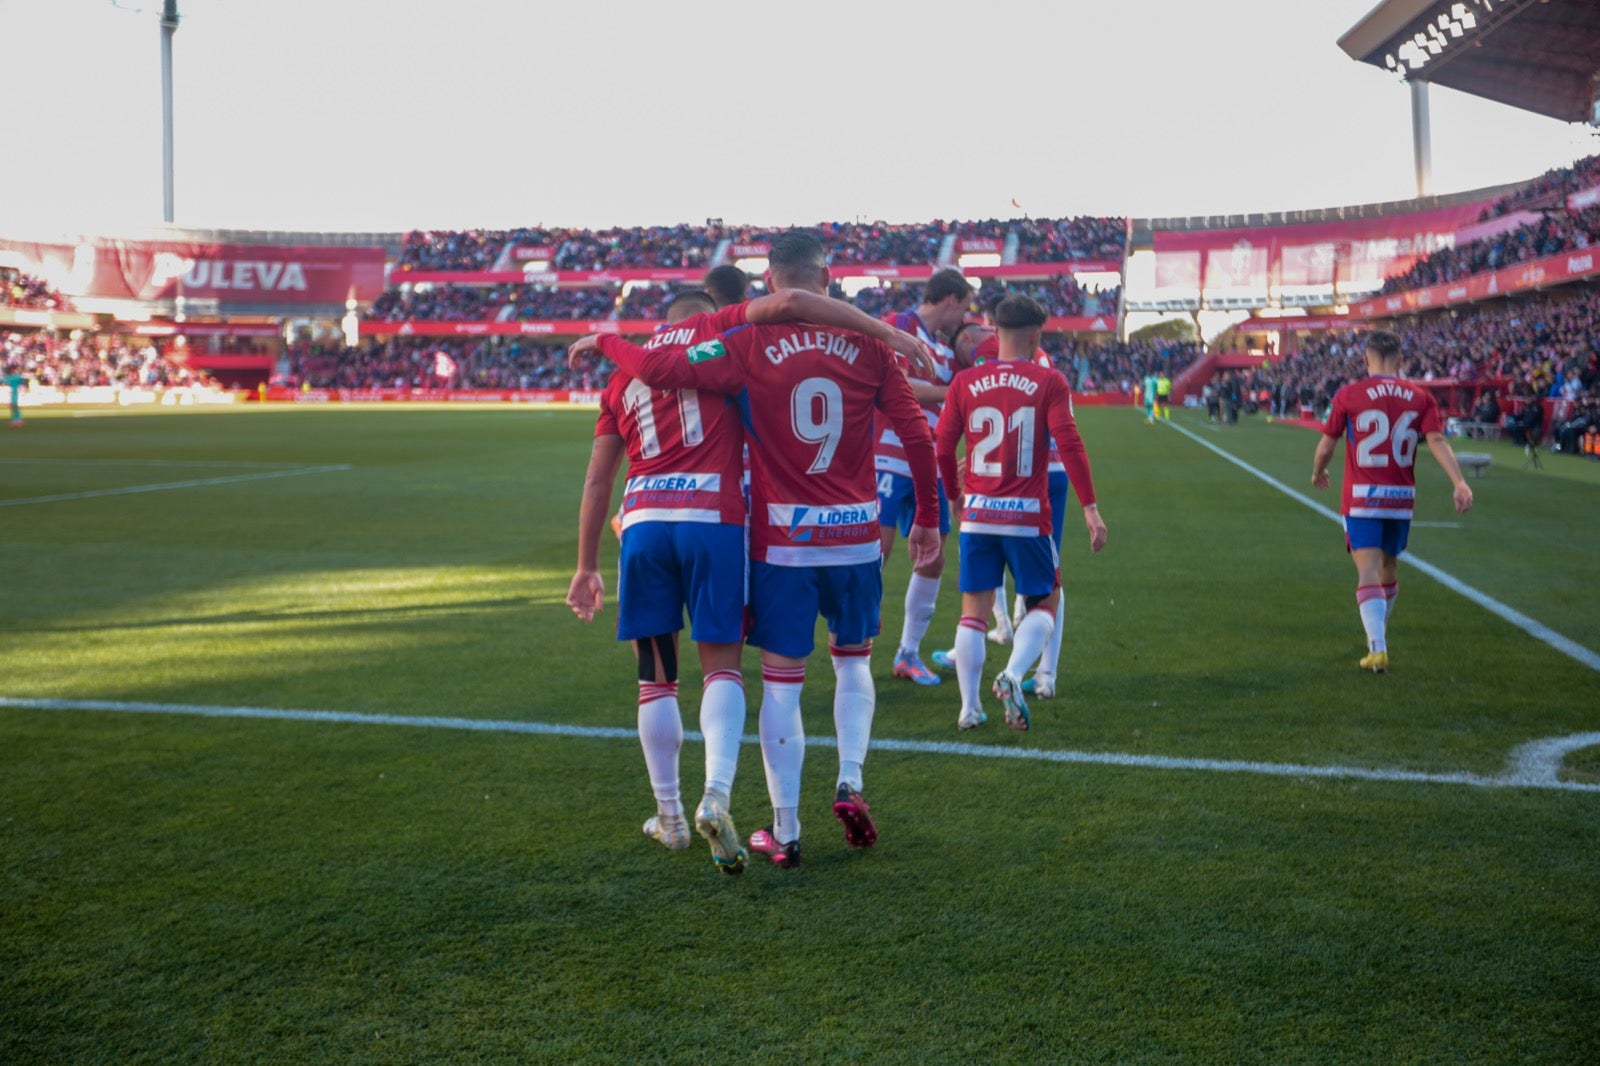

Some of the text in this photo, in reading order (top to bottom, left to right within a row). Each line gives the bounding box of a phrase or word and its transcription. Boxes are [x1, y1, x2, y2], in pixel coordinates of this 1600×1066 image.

[764, 331, 860, 365] CALLEJÓN
[968, 372, 1039, 397] MELENDO
[1366, 384, 1414, 402] BRYAN
[621, 376, 704, 460] 11
[790, 376, 844, 475] 9
[969, 406, 1036, 478] 21
[1356, 409, 1419, 468] 26
[643, 477, 697, 490] LIDERA
[876, 472, 894, 498] 4
[818, 509, 868, 525] LIDERA
[982, 498, 1024, 510] LIDERA
